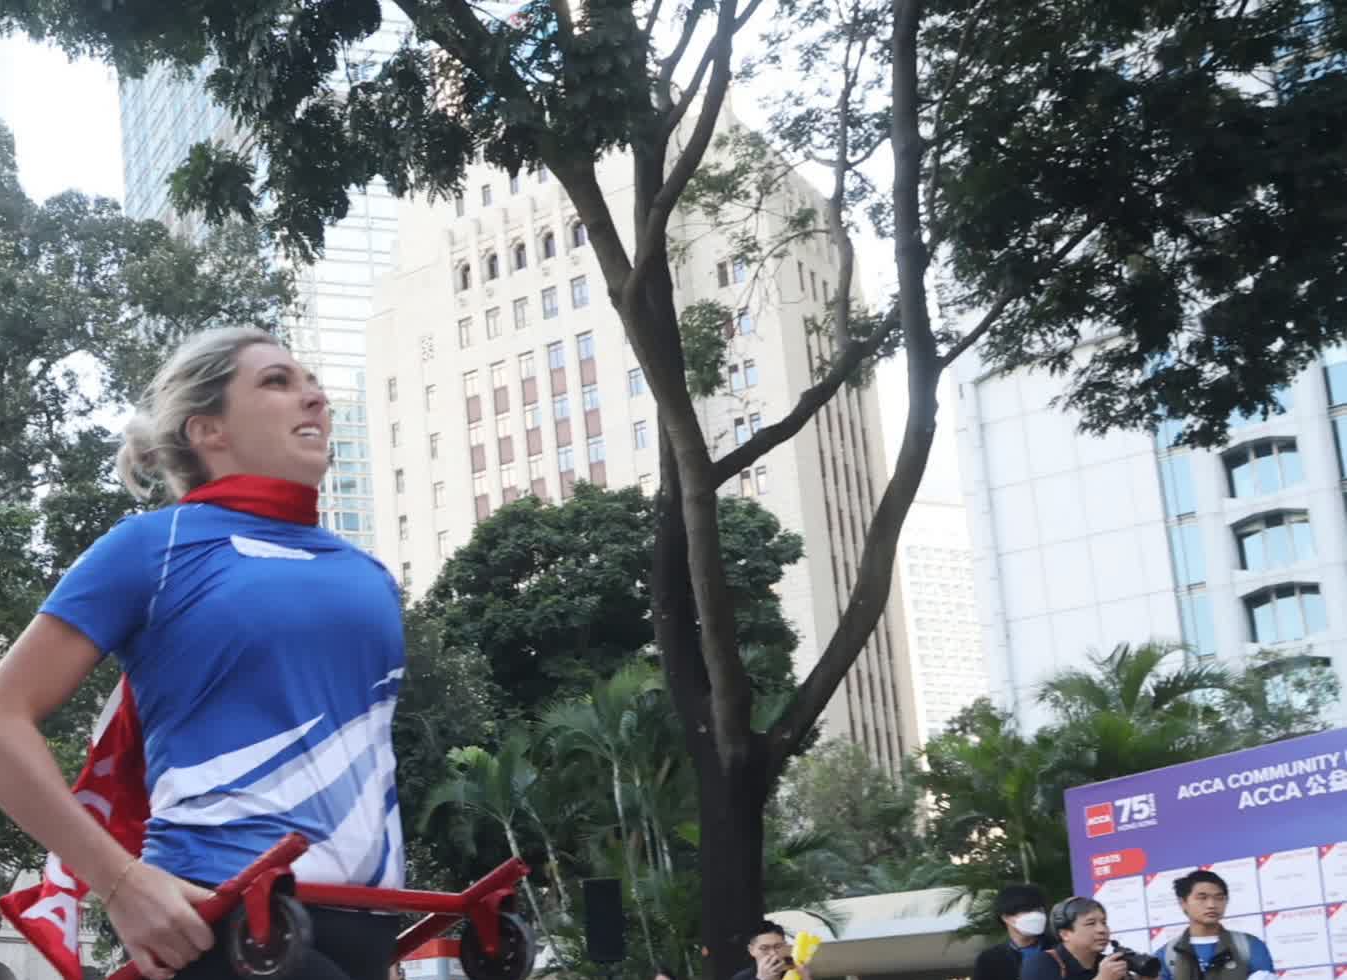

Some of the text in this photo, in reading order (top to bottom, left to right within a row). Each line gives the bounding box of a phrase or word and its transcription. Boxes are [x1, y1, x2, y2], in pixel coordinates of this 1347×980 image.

[1177, 777, 1225, 800] ACCA
[1227, 751, 1341, 789] COMMUNITY
[1115, 794, 1150, 823] 75
[1238, 781, 1302, 809] ACCA
